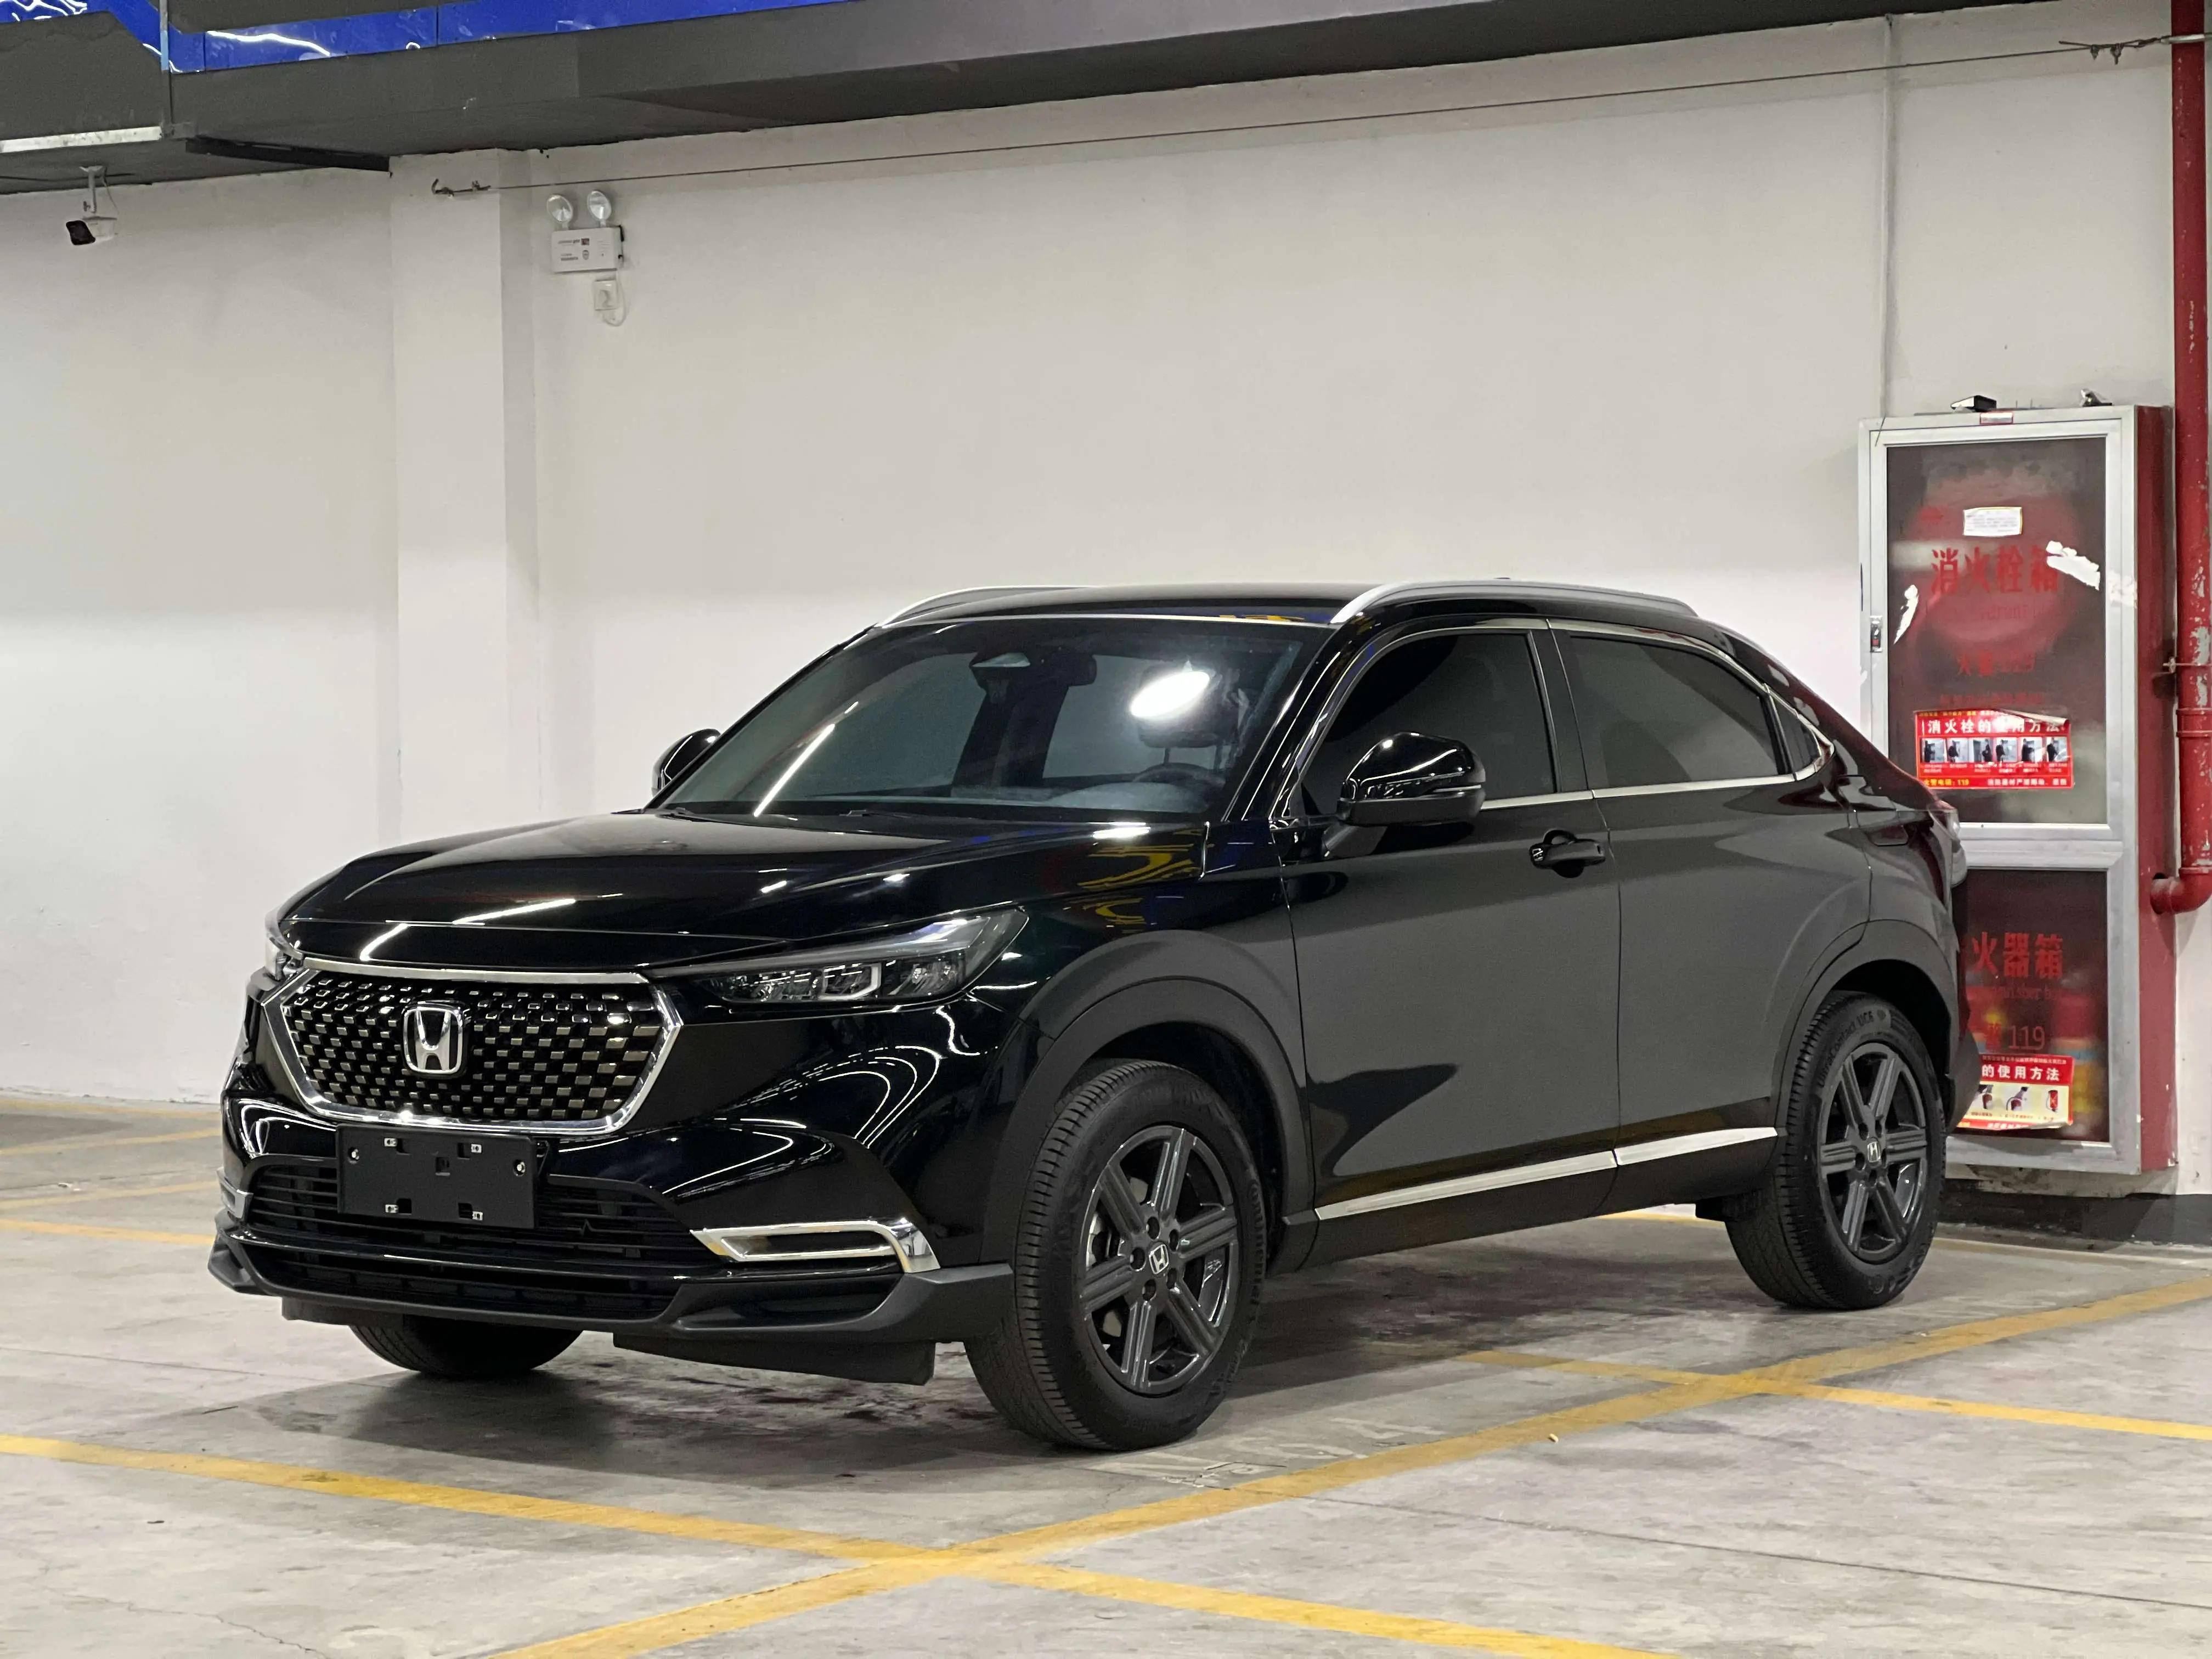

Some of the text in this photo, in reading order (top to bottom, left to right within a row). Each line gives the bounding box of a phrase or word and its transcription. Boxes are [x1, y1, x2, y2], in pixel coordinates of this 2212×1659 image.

[1928, 719, 2060, 733] 消火栓的用方法
[2008, 1025, 2045, 1050] 119
[1982, 1064, 2059, 1081] 的使用方法
